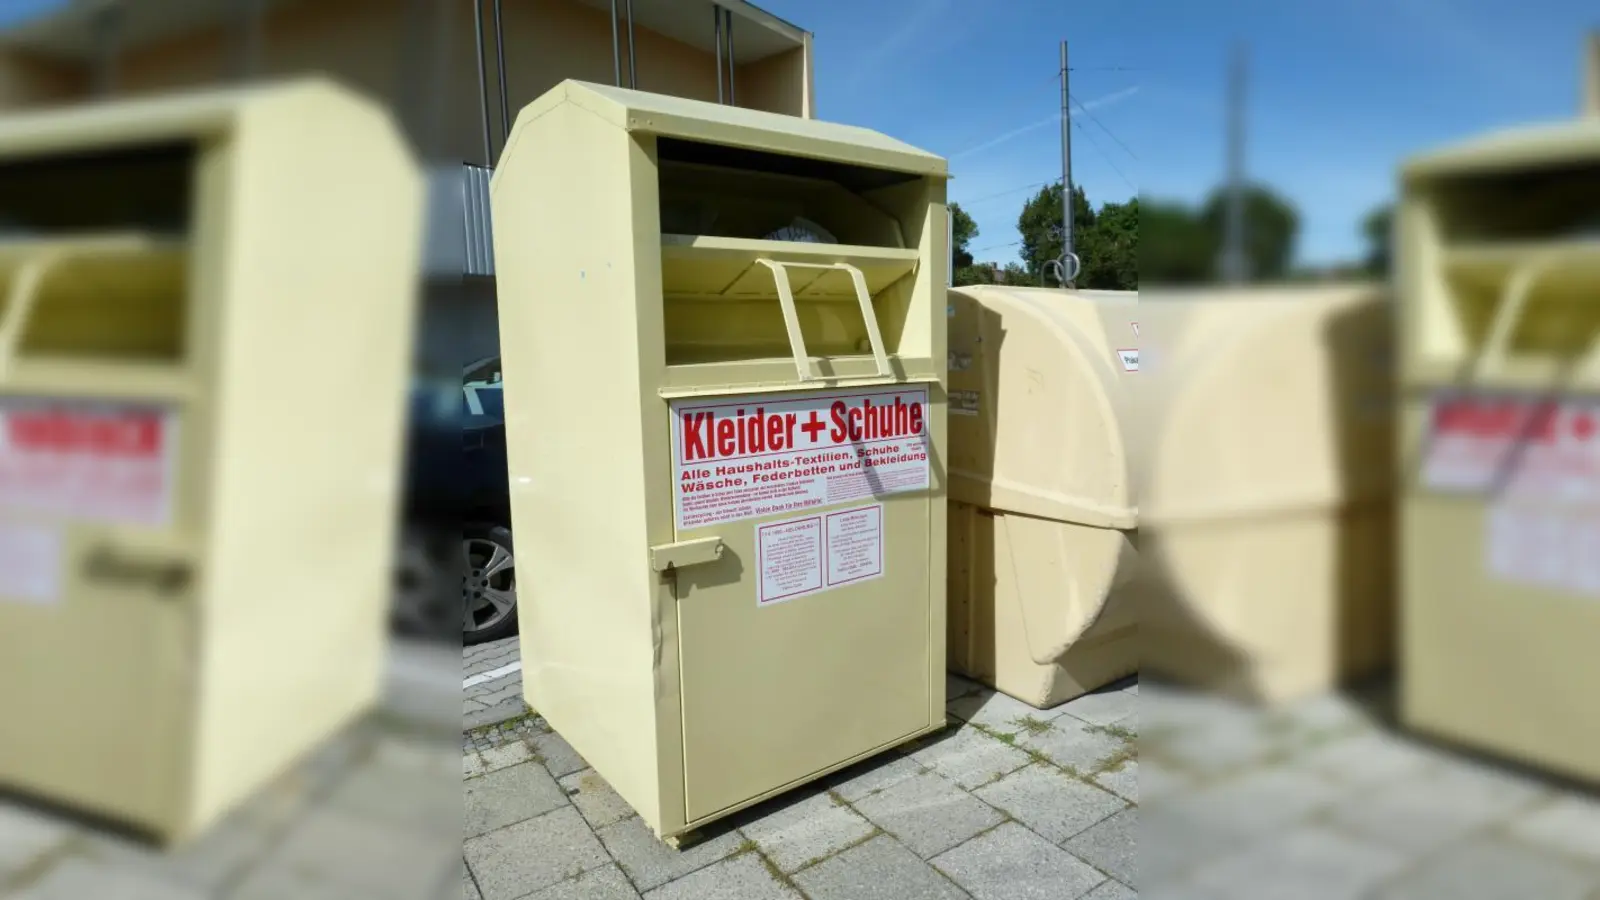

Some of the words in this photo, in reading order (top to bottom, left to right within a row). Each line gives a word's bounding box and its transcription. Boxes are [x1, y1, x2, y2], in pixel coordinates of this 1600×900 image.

[684, 407, 797, 460] Kleider
[830, 396, 923, 443] Schuhe
[681, 469, 711, 480] Alle
[715, 452, 853, 476] Haushalts-Textilien,
[857, 444, 900, 458] Schuhe
[681, 478, 748, 493] Wäsche,
[752, 464, 835, 483] Federbetten
[839, 460, 861, 471] und
[864, 452, 926, 468] Bekleidung
